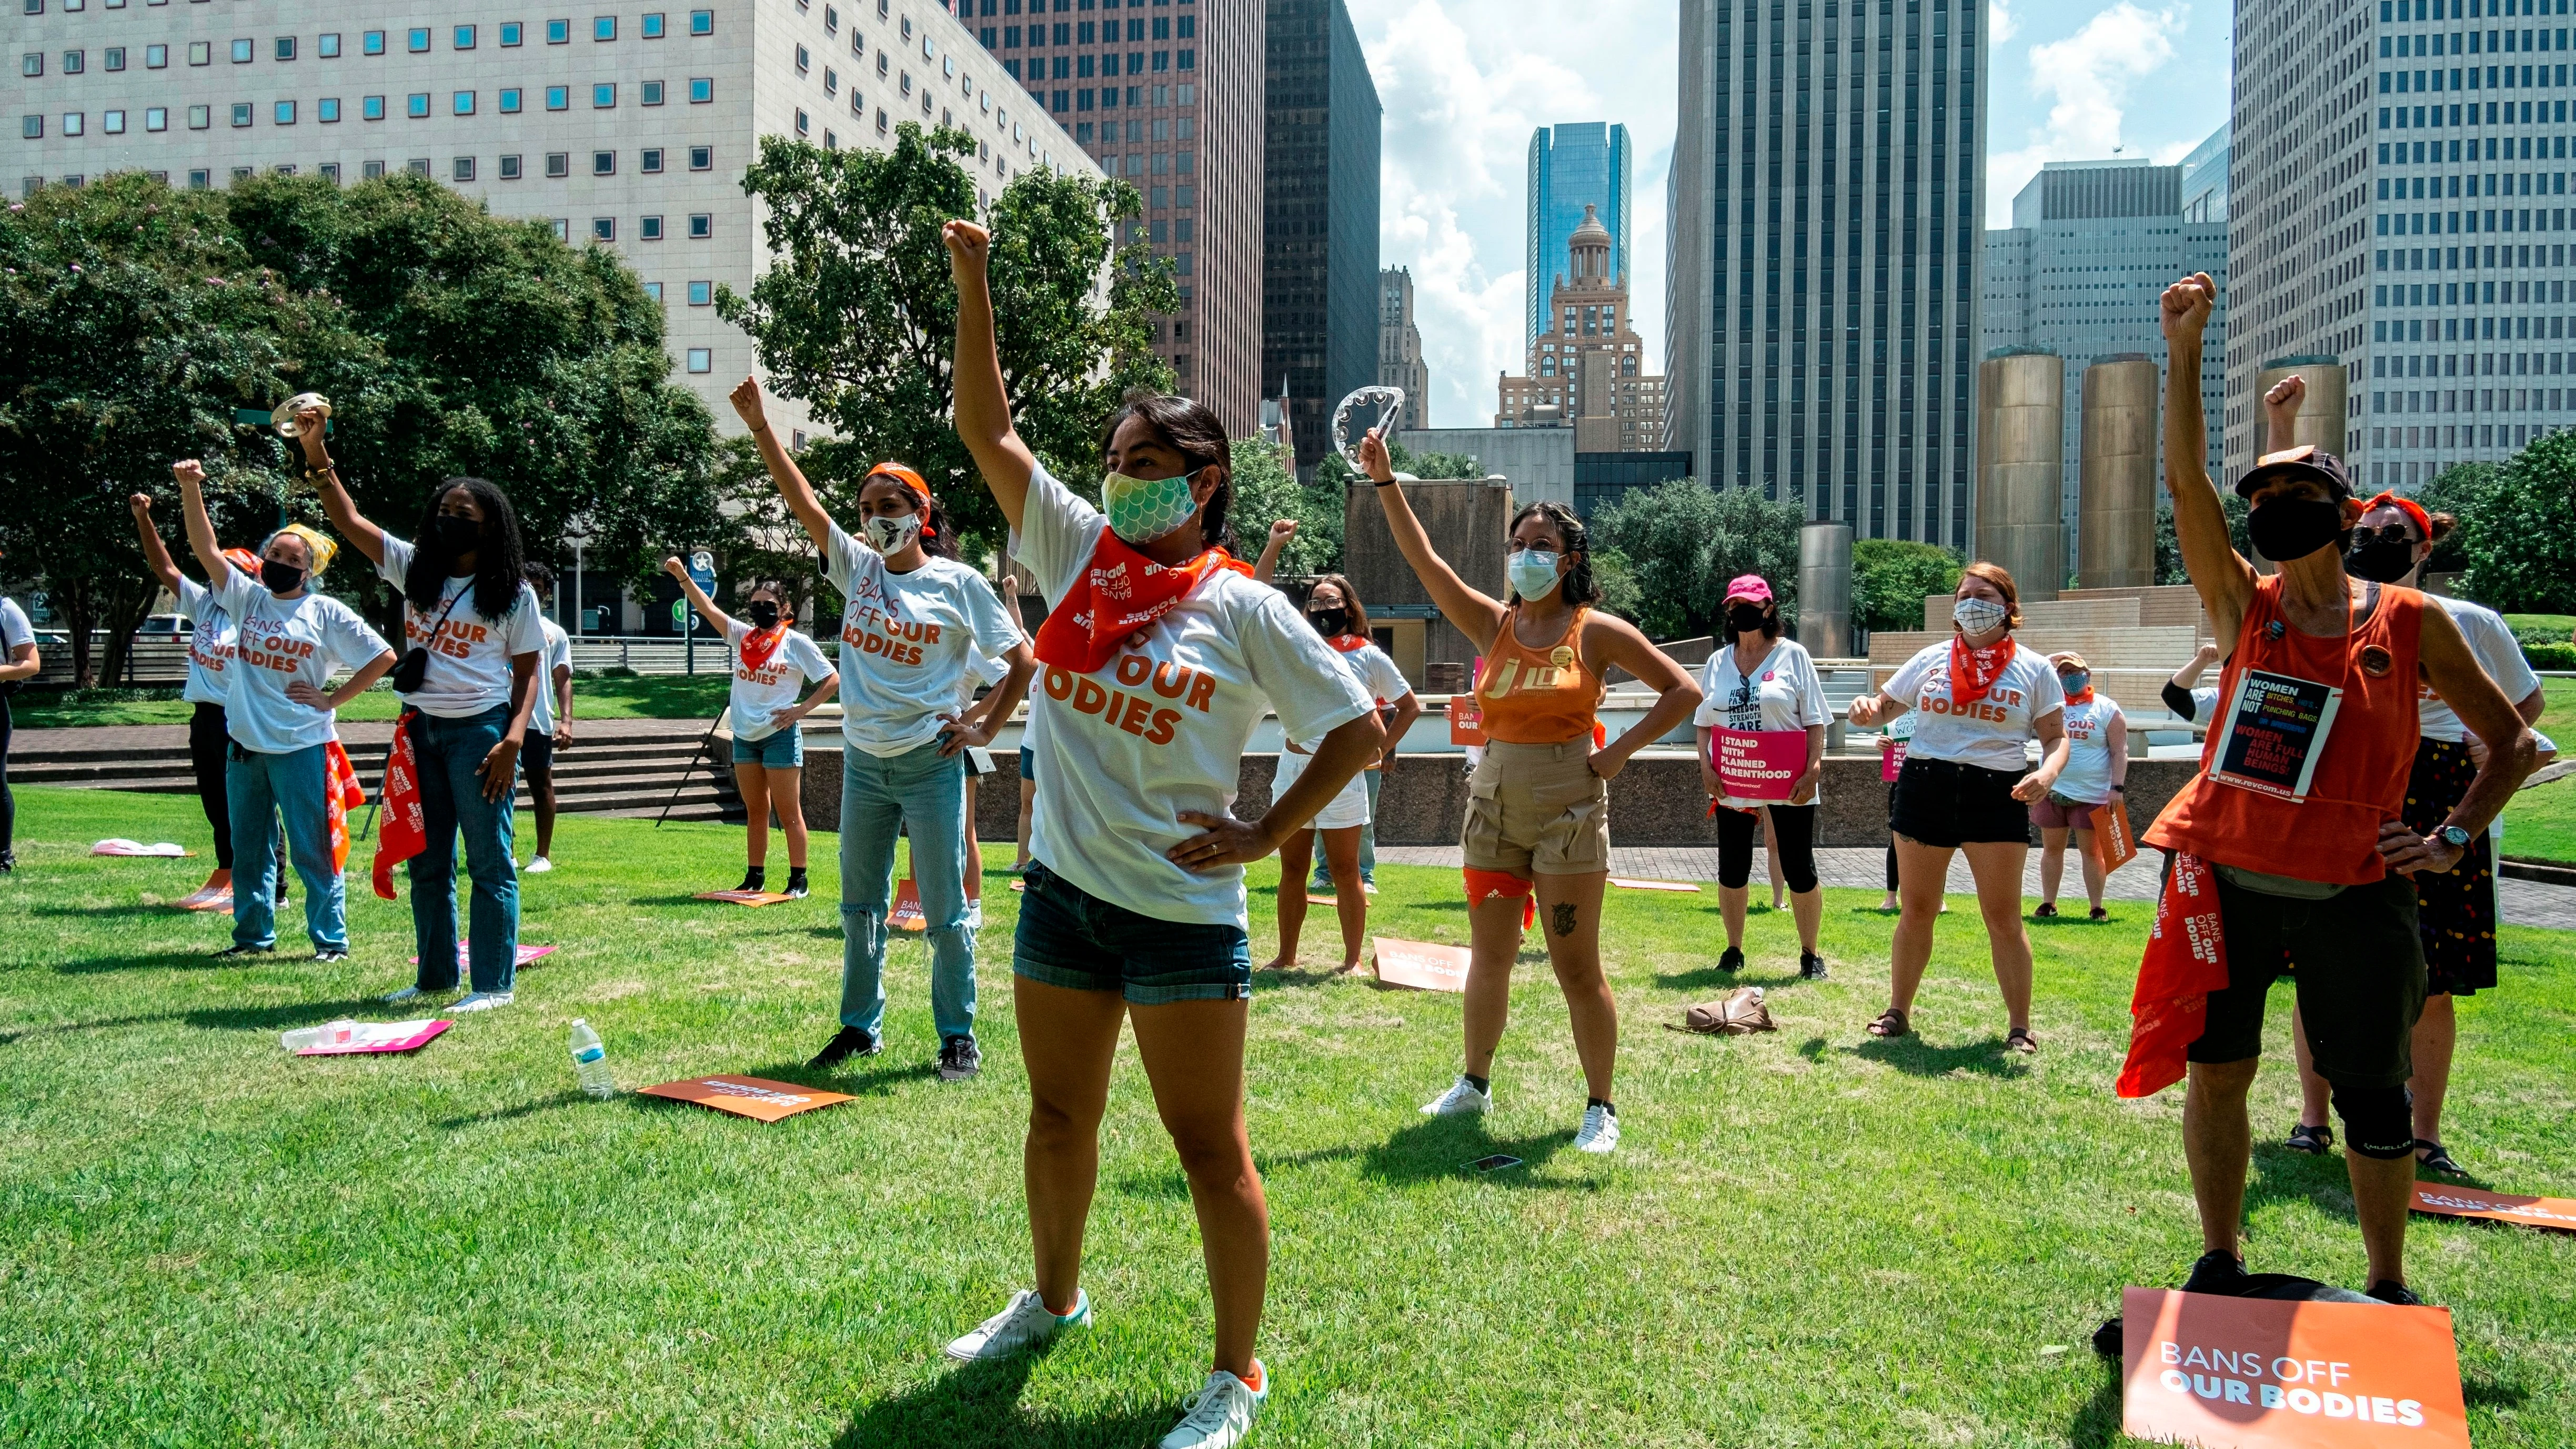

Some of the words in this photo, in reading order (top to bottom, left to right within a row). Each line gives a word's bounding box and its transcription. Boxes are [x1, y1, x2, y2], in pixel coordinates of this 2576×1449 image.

[1145, 563, 1164, 576] UR
[1091, 578, 1108, 588] OU
[1111, 576, 1130, 590] OFF
[1102, 587, 1131, 600] BANS
[677, 606, 681, 616] 1
[849, 600, 881, 627] OFF
[884, 618, 941, 644] OUR
[1073, 612, 1094, 630] UR
[435, 619, 487, 643] OUR
[265, 636, 314, 659] OUR
[842, 623, 923, 665] BODIES
[737, 667, 778, 686] ODIES
[1116, 655, 1216, 713] OUR
[2245, 688, 2265, 701] ARE
[2266, 692, 2295, 705] BITCHES,
[2250, 679, 2299, 696] WOMEN
[1044, 663, 1183, 745] ODIES
[1991, 688, 2020, 708] UR
[1729, 712, 1762, 722] STRENGTH
[1921, 696, 2008, 723] BODIES
[2241, 700, 2261, 713] NOT
[2262, 705, 2296, 718] PUNCHING
[1725, 737, 1758, 748] STAND
[2069, 730, 2089, 740] IES
[2236, 724, 2283, 743] WOMEN
[1722, 746, 1745, 757] WITH
[2247, 748, 2290, 763] HUMAN
[2249, 739, 2273, 751] ARE
[2275, 744, 2304, 759] FULL
[1721, 756, 1766, 768] PLANNED
[2243, 757, 2290, 776] BEINGS!
[2220, 773, 2291, 797] www.revcom.us
[407, 801, 419, 817] OUR
[407, 815, 420, 833] BANS
[2113, 840, 2122, 862] BANS
[2181, 851, 2192, 870] OFF
[2175, 852, 2186, 893] BODIES
[2193, 856, 2205, 876] ANS
[2185, 871, 2199, 897] OUR
[2196, 915, 2210, 936] OFF
[2207, 913, 2222, 942] BANS
[2185, 917, 2205, 960] BODIES
[1389, 951, 1425, 962] BANS
[1428, 957, 1453, 968] OFF
[2202, 938, 2217, 964] OUR
[1425, 964, 1462, 978] BODI
[702, 1081, 772, 1094] BODIES
[768, 1092, 812, 1102] OUR
[746, 1094, 798, 1106] BANS
[2419, 1192, 2489, 1206] BANS
[2496, 1204, 2549, 1213] OFF
[2422, 1199, 2488, 1210] OUR
[2160, 1341, 2262, 1378] BANS
[2272, 1356, 2349, 1387] OFF
[2159, 1369, 2252, 1405] OUR
[2259, 1383, 2424, 1427] BODIES
